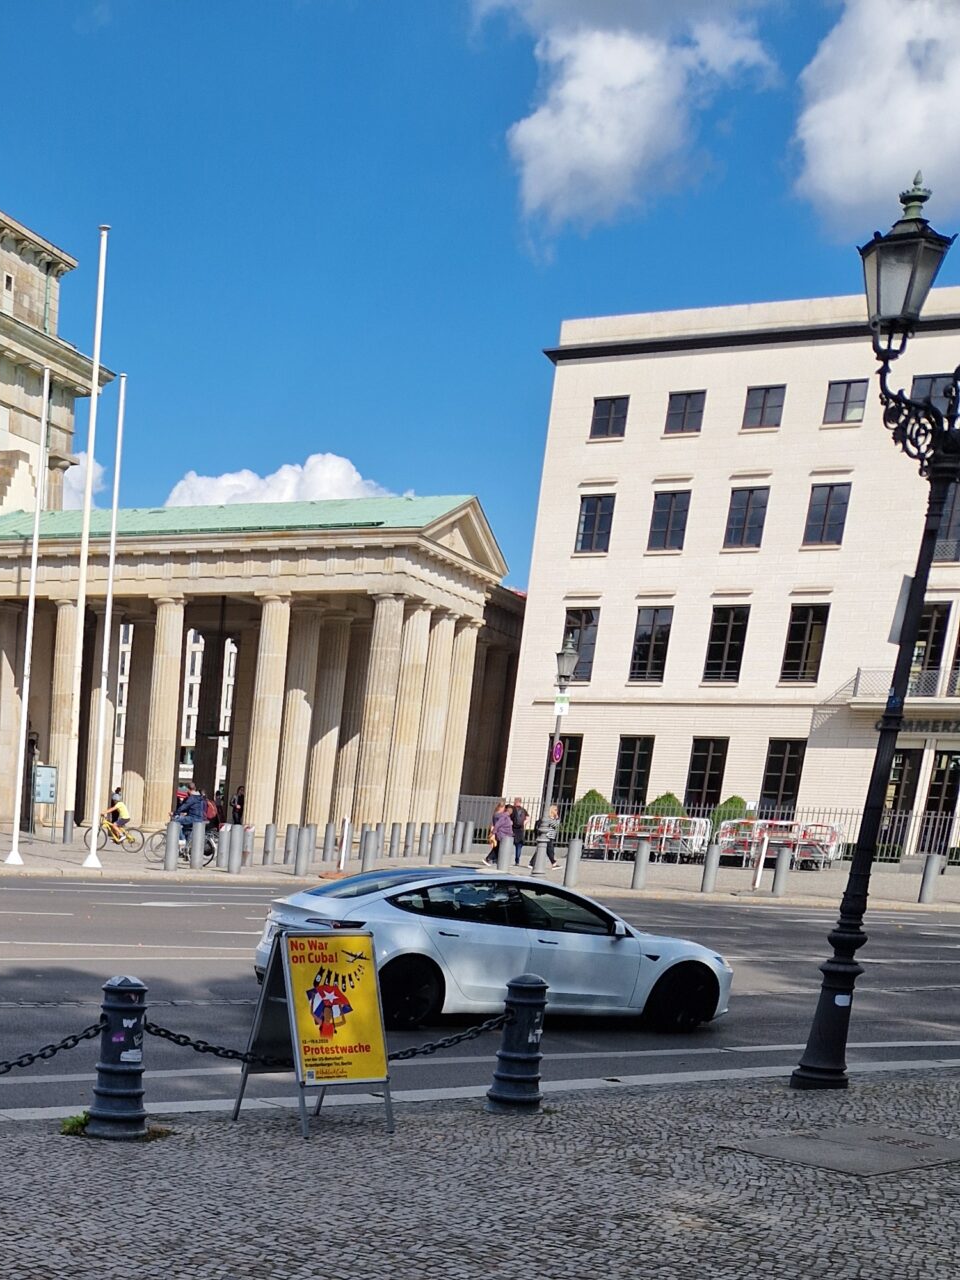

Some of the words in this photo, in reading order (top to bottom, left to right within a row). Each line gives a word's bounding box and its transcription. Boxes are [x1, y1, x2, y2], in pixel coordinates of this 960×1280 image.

[290, 940, 305, 952] No
[307, 940, 328, 951] War
[291, 955, 305, 964] on
[307, 952, 338, 964] Cuba!
[303, 1042, 371, 1056] Protestwache
